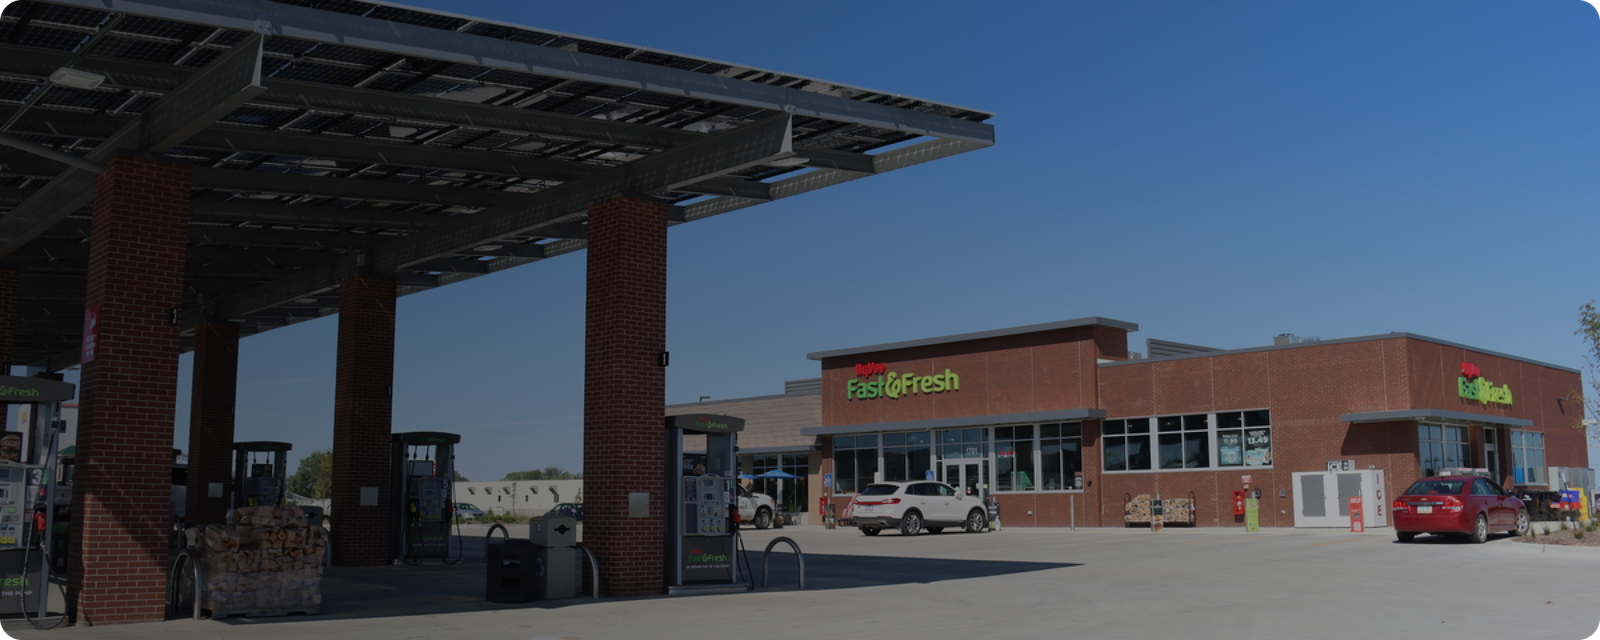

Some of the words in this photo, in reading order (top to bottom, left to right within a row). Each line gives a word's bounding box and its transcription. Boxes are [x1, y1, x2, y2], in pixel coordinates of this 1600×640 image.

[1247, 435, 1269, 445] 13.49
[31, 468, 42, 485] 3
[443, 479, 449, 489] 5
